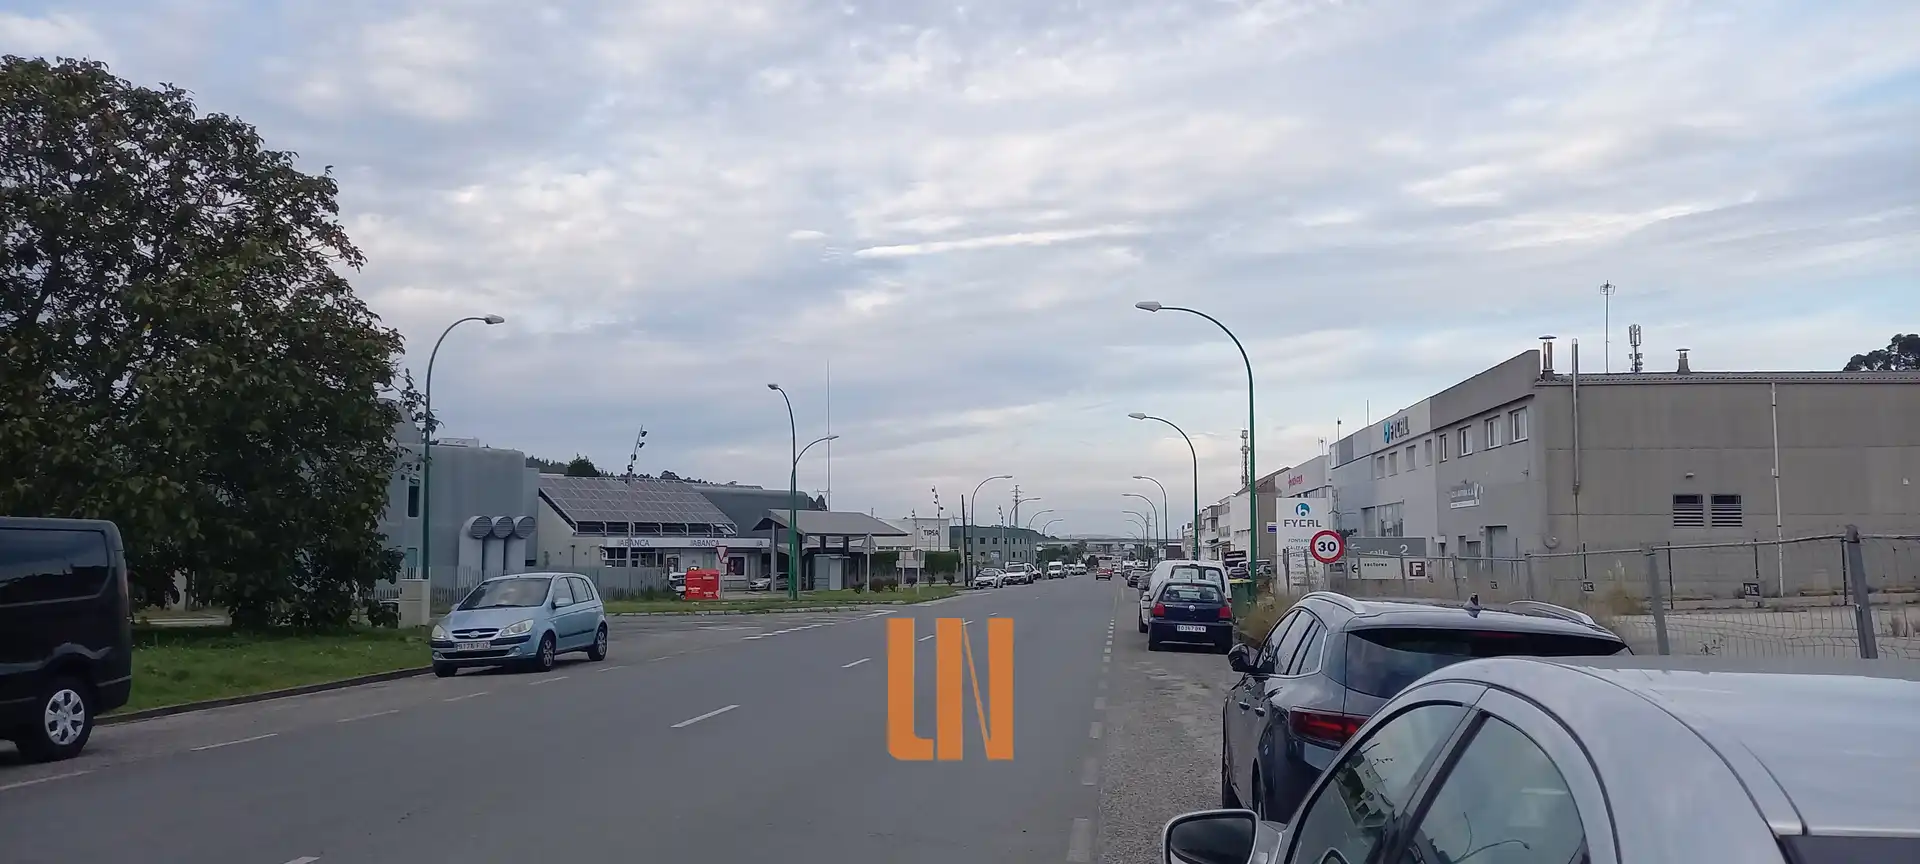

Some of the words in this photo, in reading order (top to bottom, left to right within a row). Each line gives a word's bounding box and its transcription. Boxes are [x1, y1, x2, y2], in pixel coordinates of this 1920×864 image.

[1284, 519, 1322, 527] FYCAL
[618, 537, 650, 547] ABANCA
[690, 537, 720, 547] ABANCA
[1317, 541, 1337, 552] 30
[1400, 544, 1409, 556] 2
[1411, 562, 1422, 576] F
